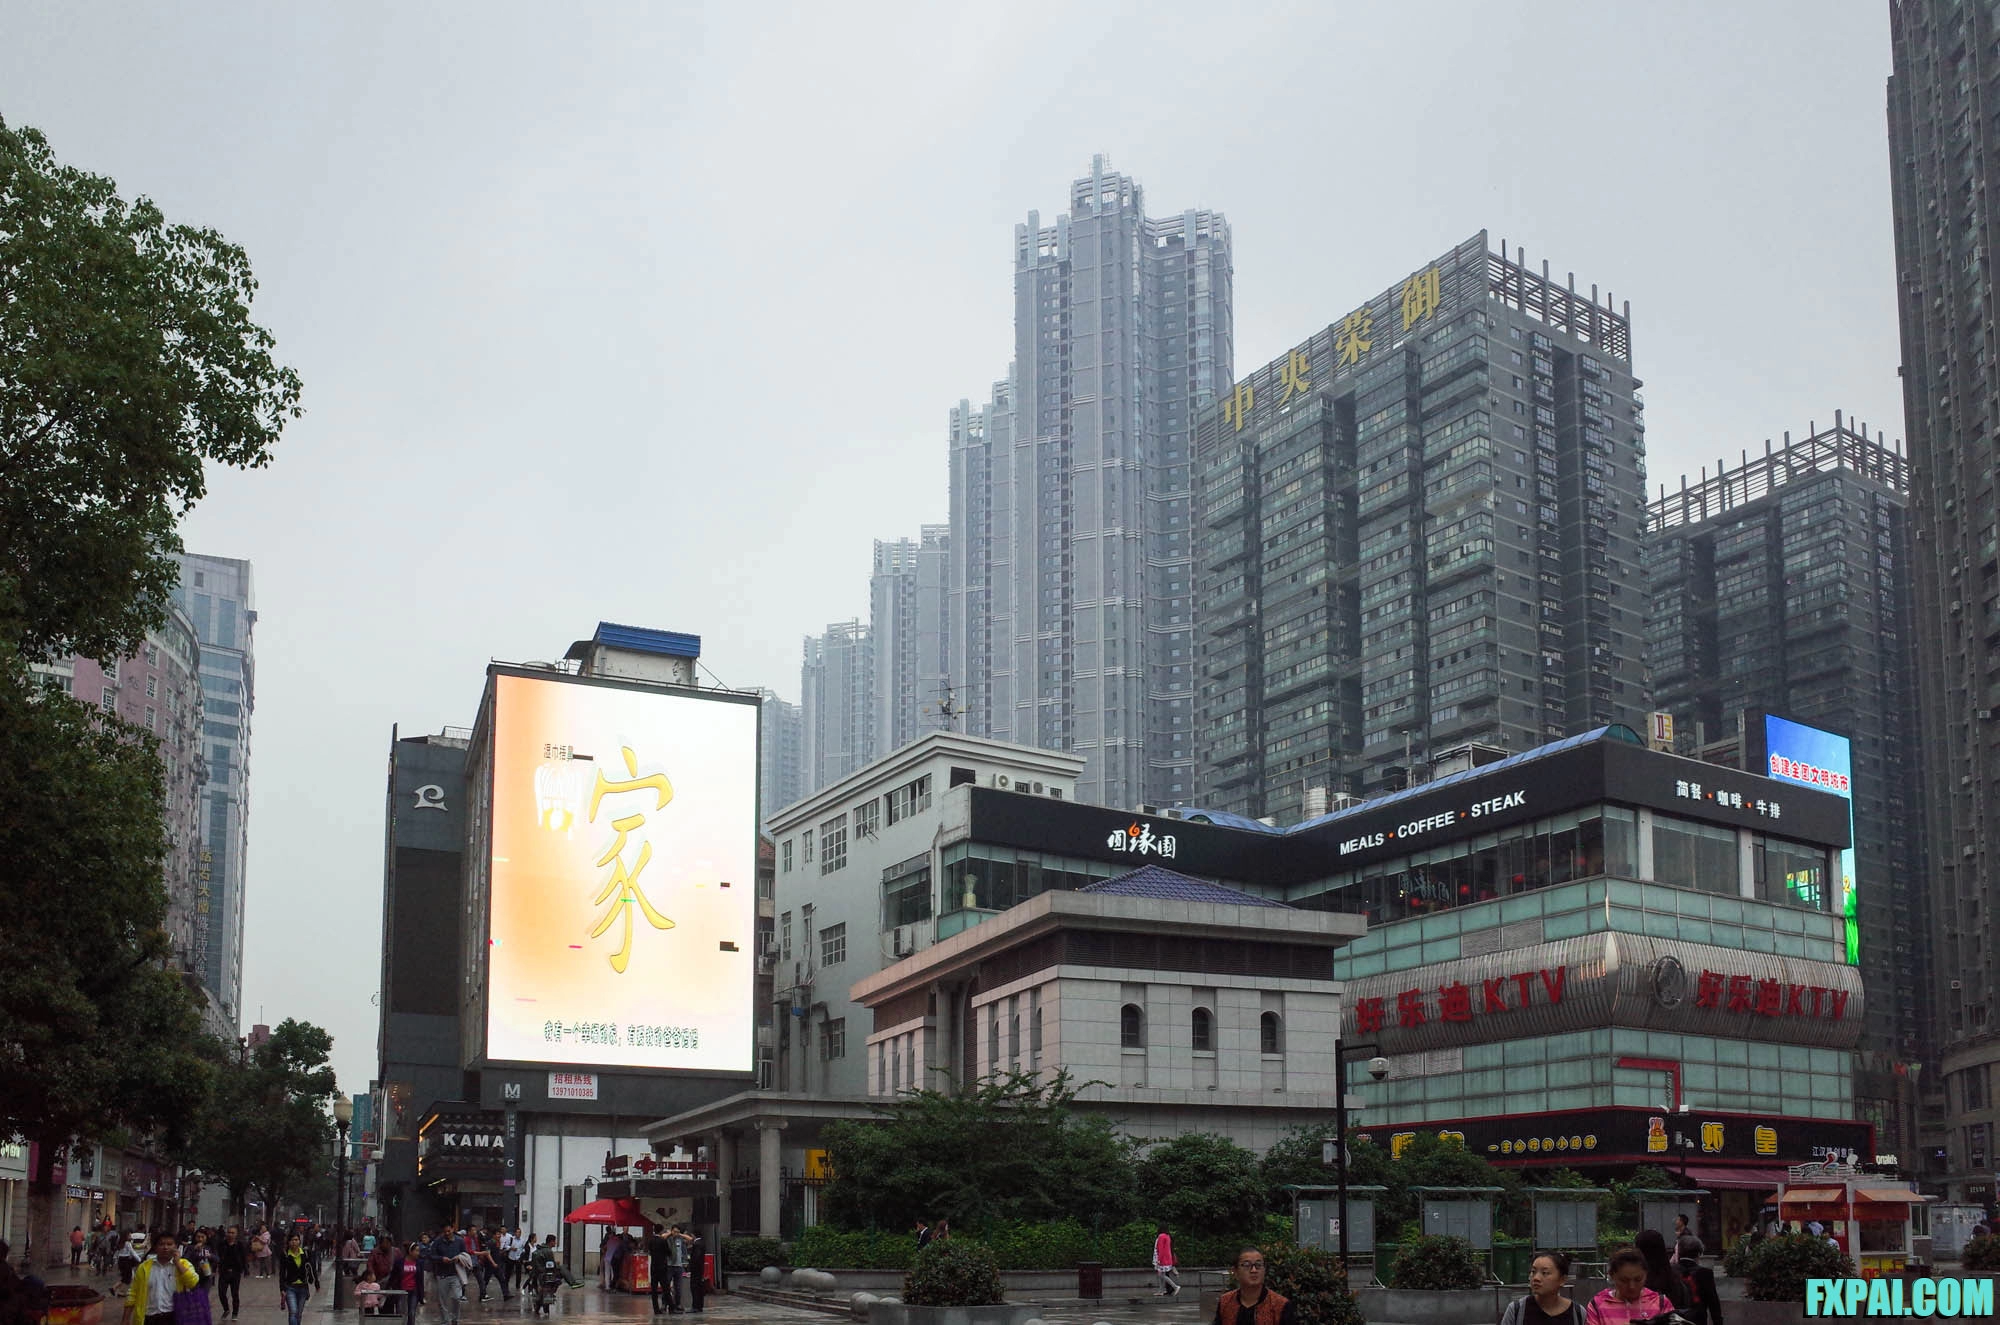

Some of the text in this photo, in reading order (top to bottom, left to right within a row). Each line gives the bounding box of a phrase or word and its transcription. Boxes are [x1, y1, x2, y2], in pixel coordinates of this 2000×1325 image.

[1224, 267, 1441, 432] 中央荣御
[1769, 754, 1849, 792] 创建全国文明城市
[1340, 790, 1526, 856] MEALS COFFEE STEAK
[1755, 799, 1781, 819] 牛排
[588, 745, 676, 974] 家
[552, 1087, 594, 1098] 13971010385
[554, 1073, 592, 1086] 招租热线
